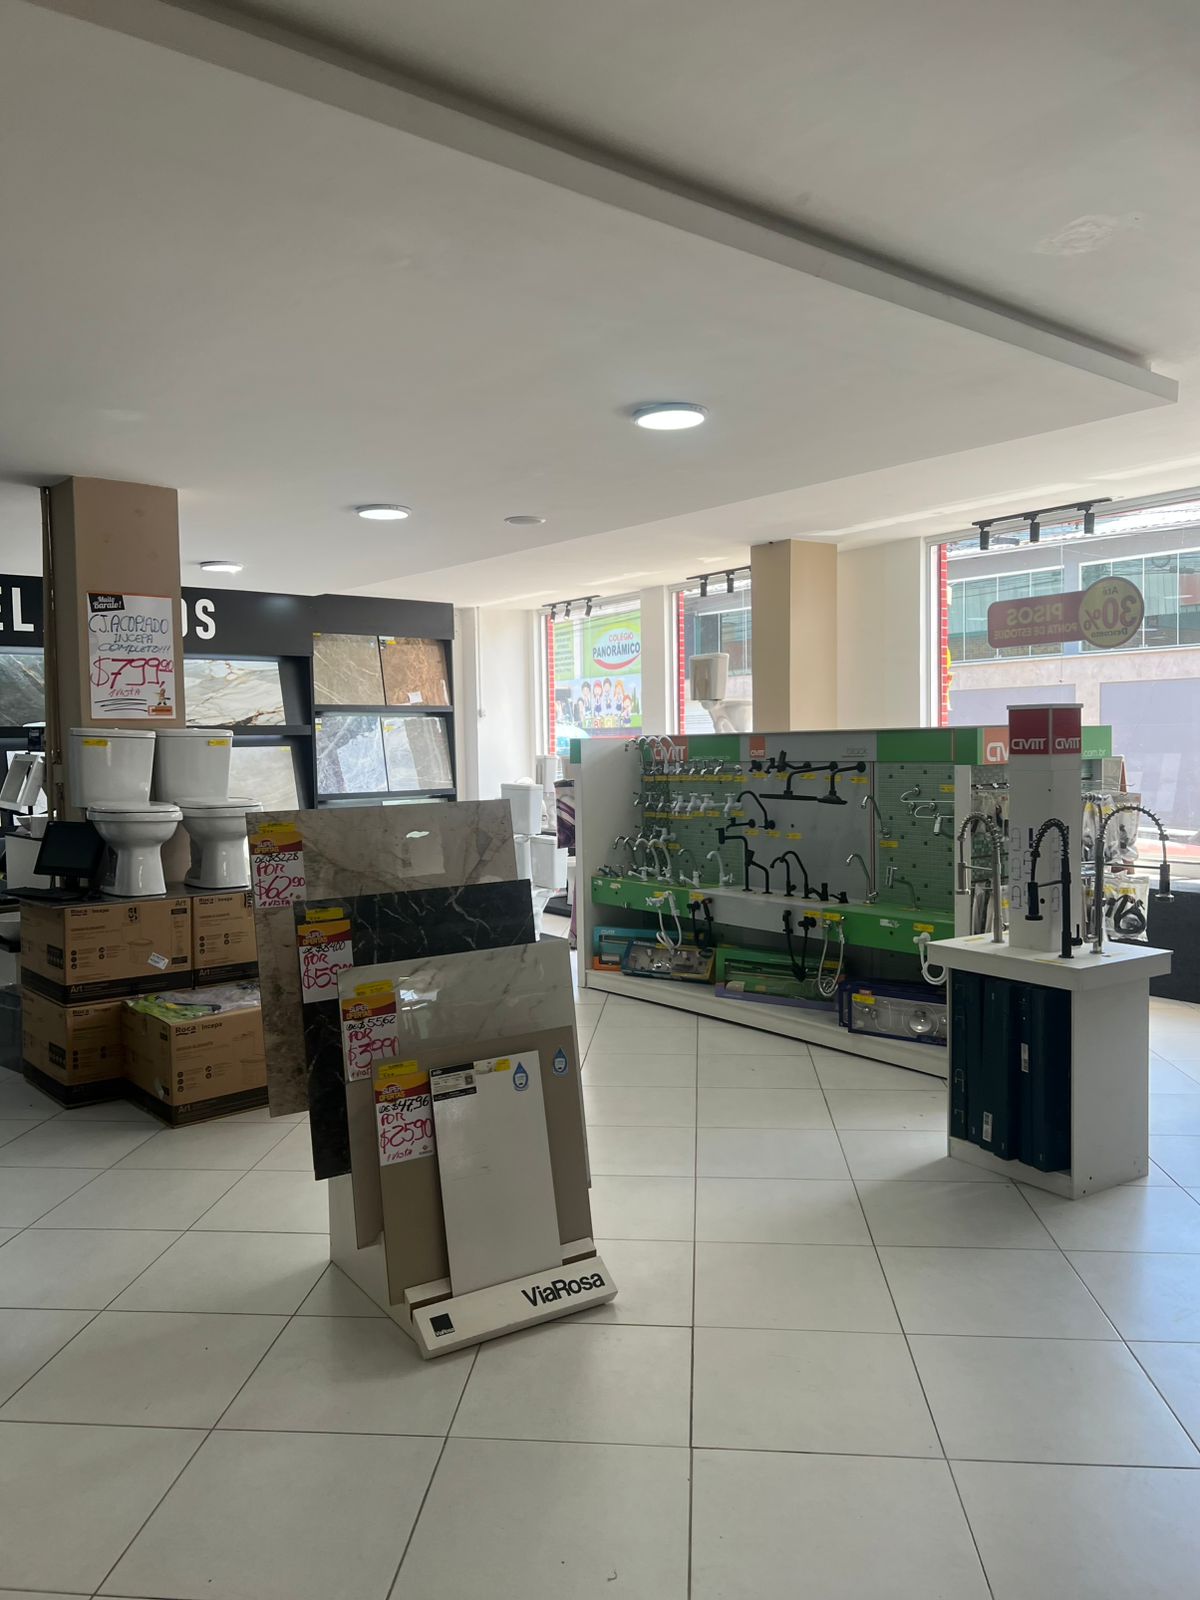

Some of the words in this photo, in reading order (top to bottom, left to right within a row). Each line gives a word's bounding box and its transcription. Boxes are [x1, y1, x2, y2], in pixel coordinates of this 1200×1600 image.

[609, 632, 634, 642] COLÉGIO
[593, 642, 640, 658] PANORÂMICO
[256, 862, 285, 876] POR
[175, 1025, 197, 1035] Roca
[349, 1028, 372, 1043] POR
[381, 1112, 406, 1127] POR
[521, 1273, 605, 1307] ViaRosa
